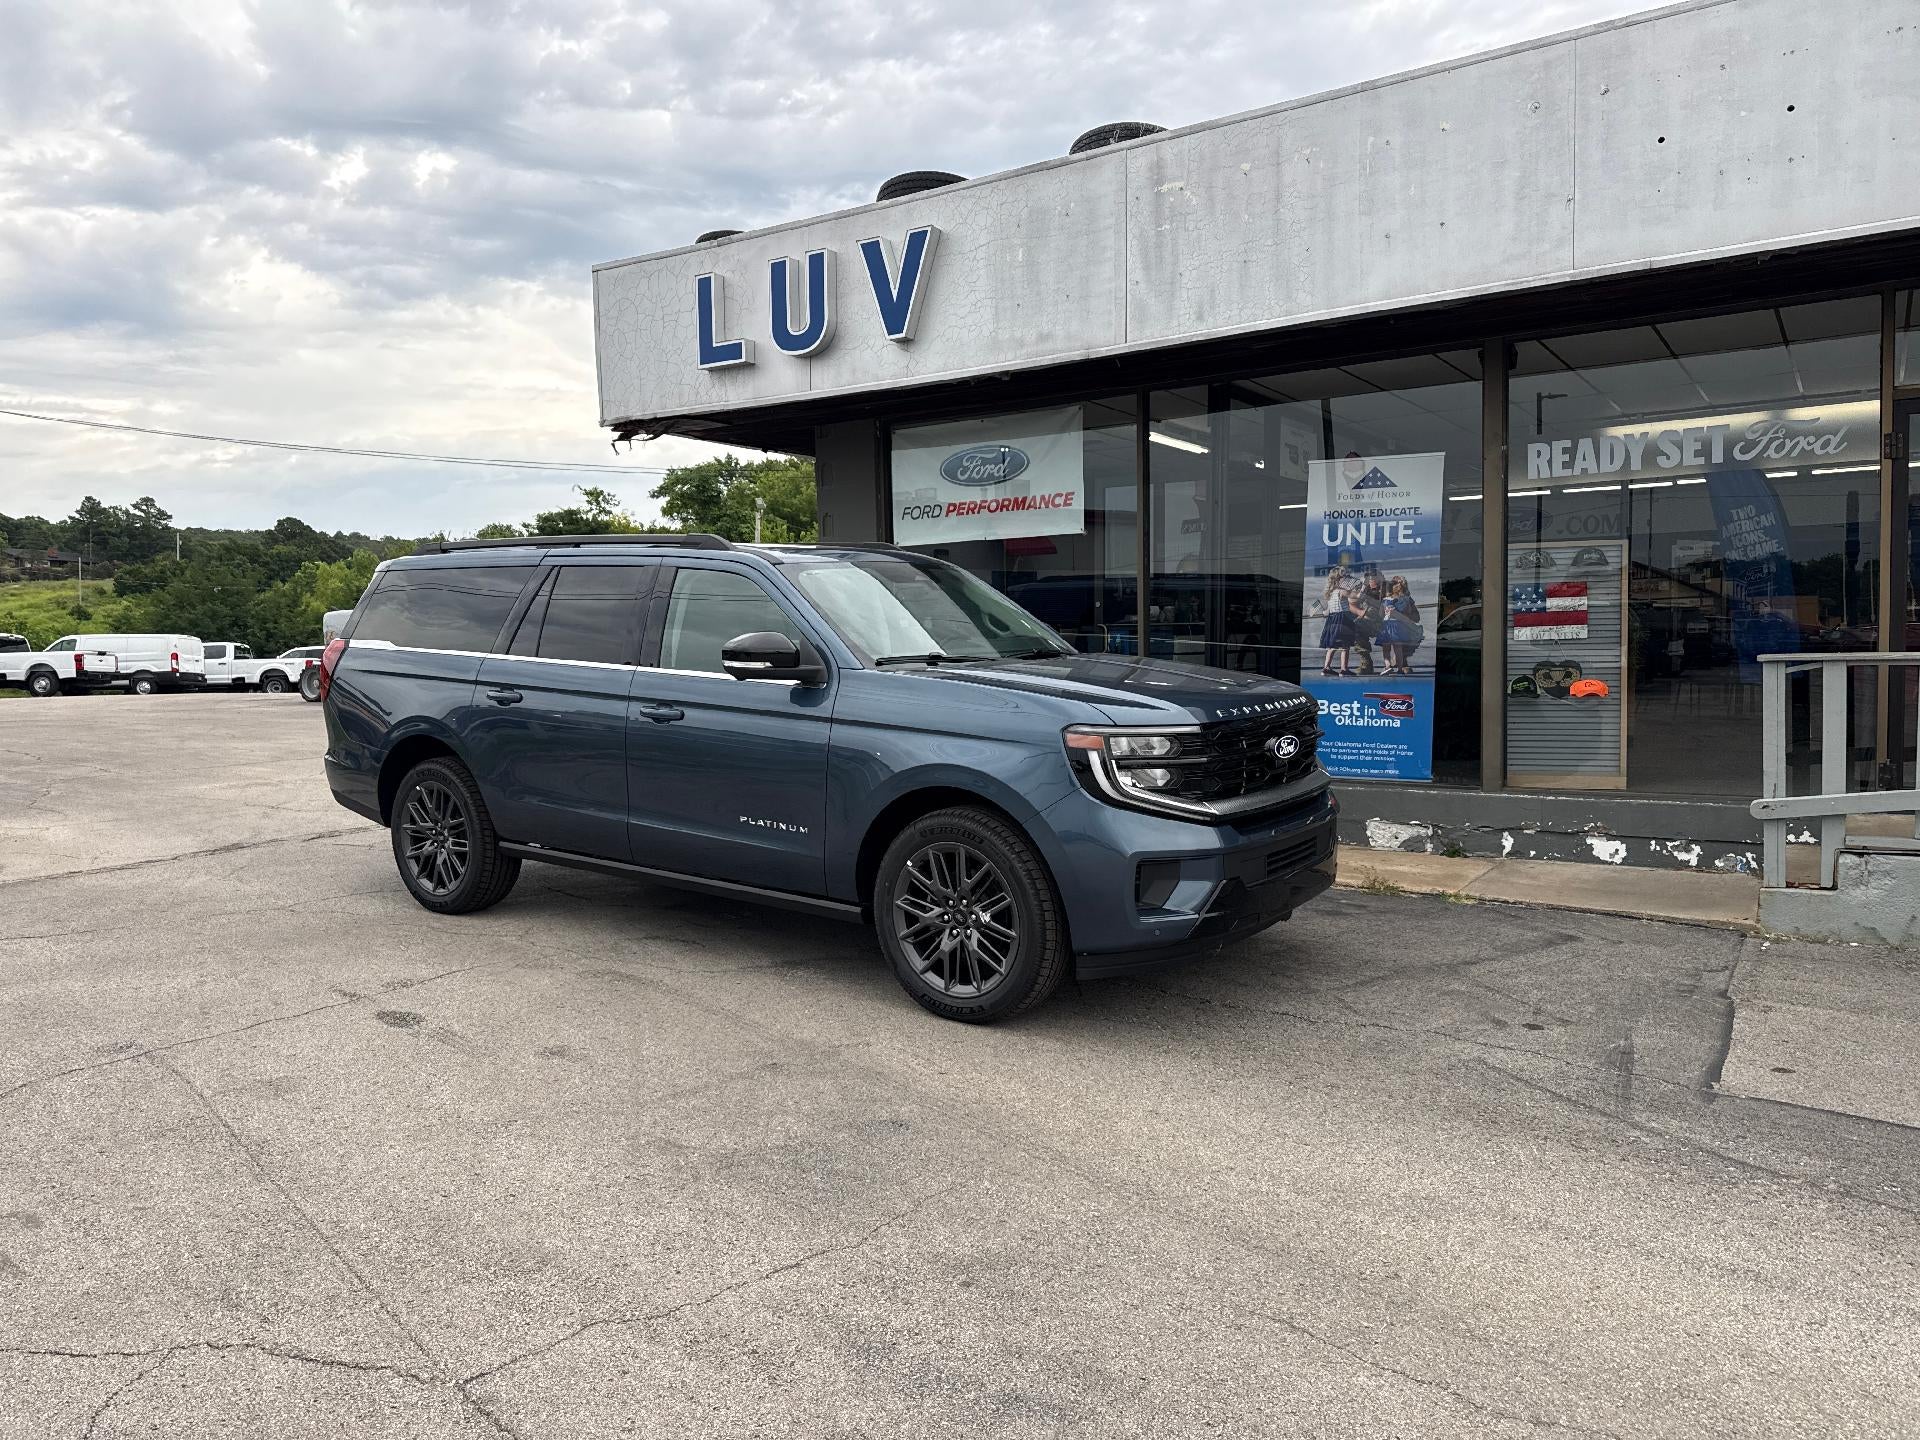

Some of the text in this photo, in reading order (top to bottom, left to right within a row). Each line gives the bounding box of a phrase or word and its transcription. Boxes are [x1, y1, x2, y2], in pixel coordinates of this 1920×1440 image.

[694, 224, 940, 371] LUV
[1527, 416, 1854, 480] READY SET Ford
[953, 445, 1016, 485] Ford
[901, 491, 1075, 521] FORD PERFORMANCE
[1323, 506, 1423, 520] HONOR. EDUCATE.
[1728, 504, 1757, 521] TWO
[1322, 520, 1423, 547] UNITE.
[1722, 511, 1776, 539] AMERICAN
[1746, 539, 1784, 559] GAME.
[1316, 699, 1411, 716] Best in Ford
[1335, 715, 1401, 728] Oklahoma
[1278, 738, 1297, 757] Ford
[738, 815, 809, 834] PLATINUM
